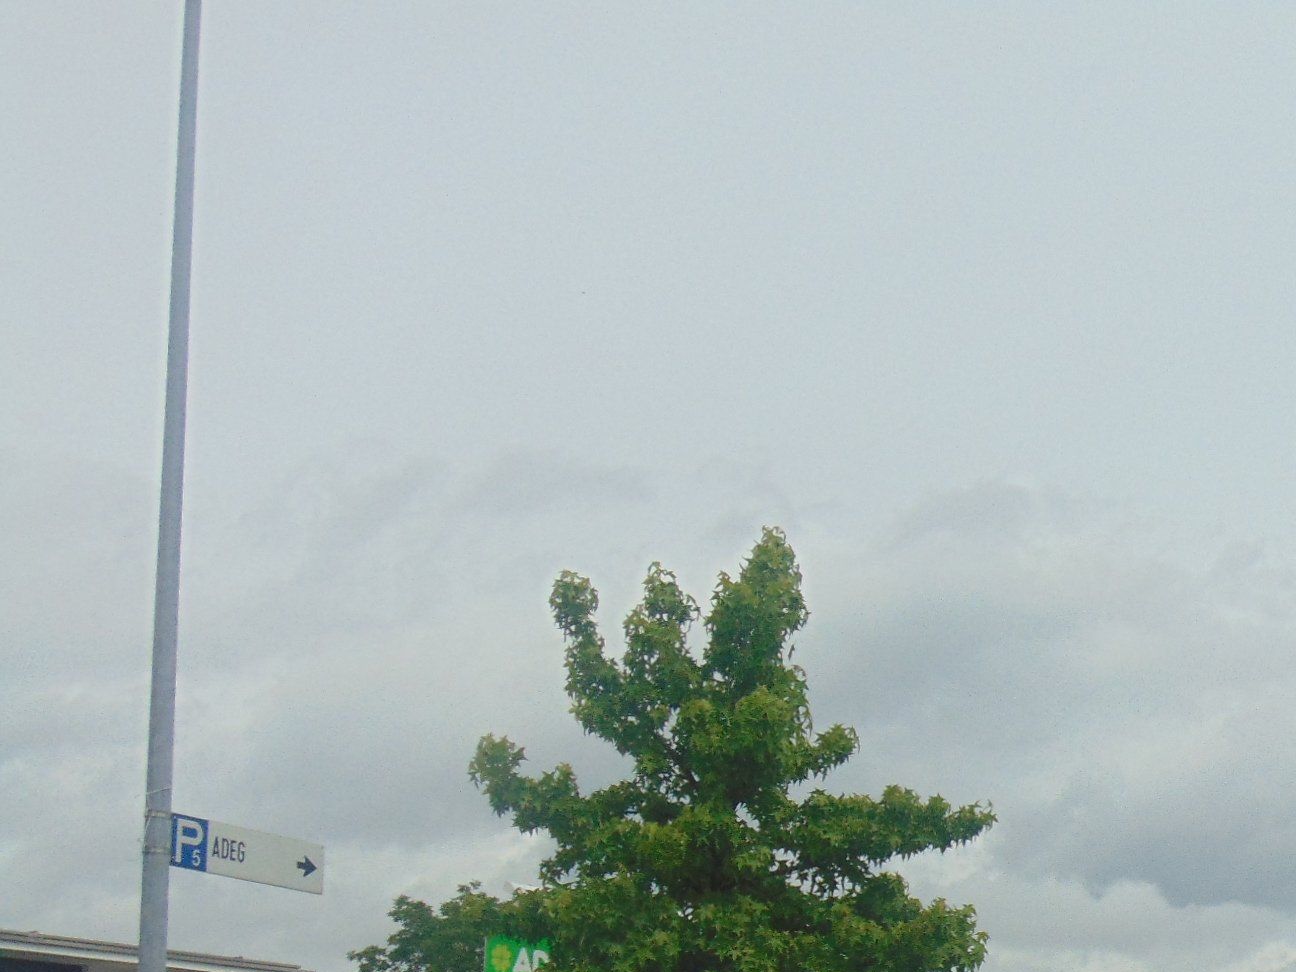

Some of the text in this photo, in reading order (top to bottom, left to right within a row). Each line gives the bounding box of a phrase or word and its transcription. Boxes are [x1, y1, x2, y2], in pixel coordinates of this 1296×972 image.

[175, 819, 203, 862] P
[212, 836, 245, 863] ADEG
[192, 849, 201, 866] 5
